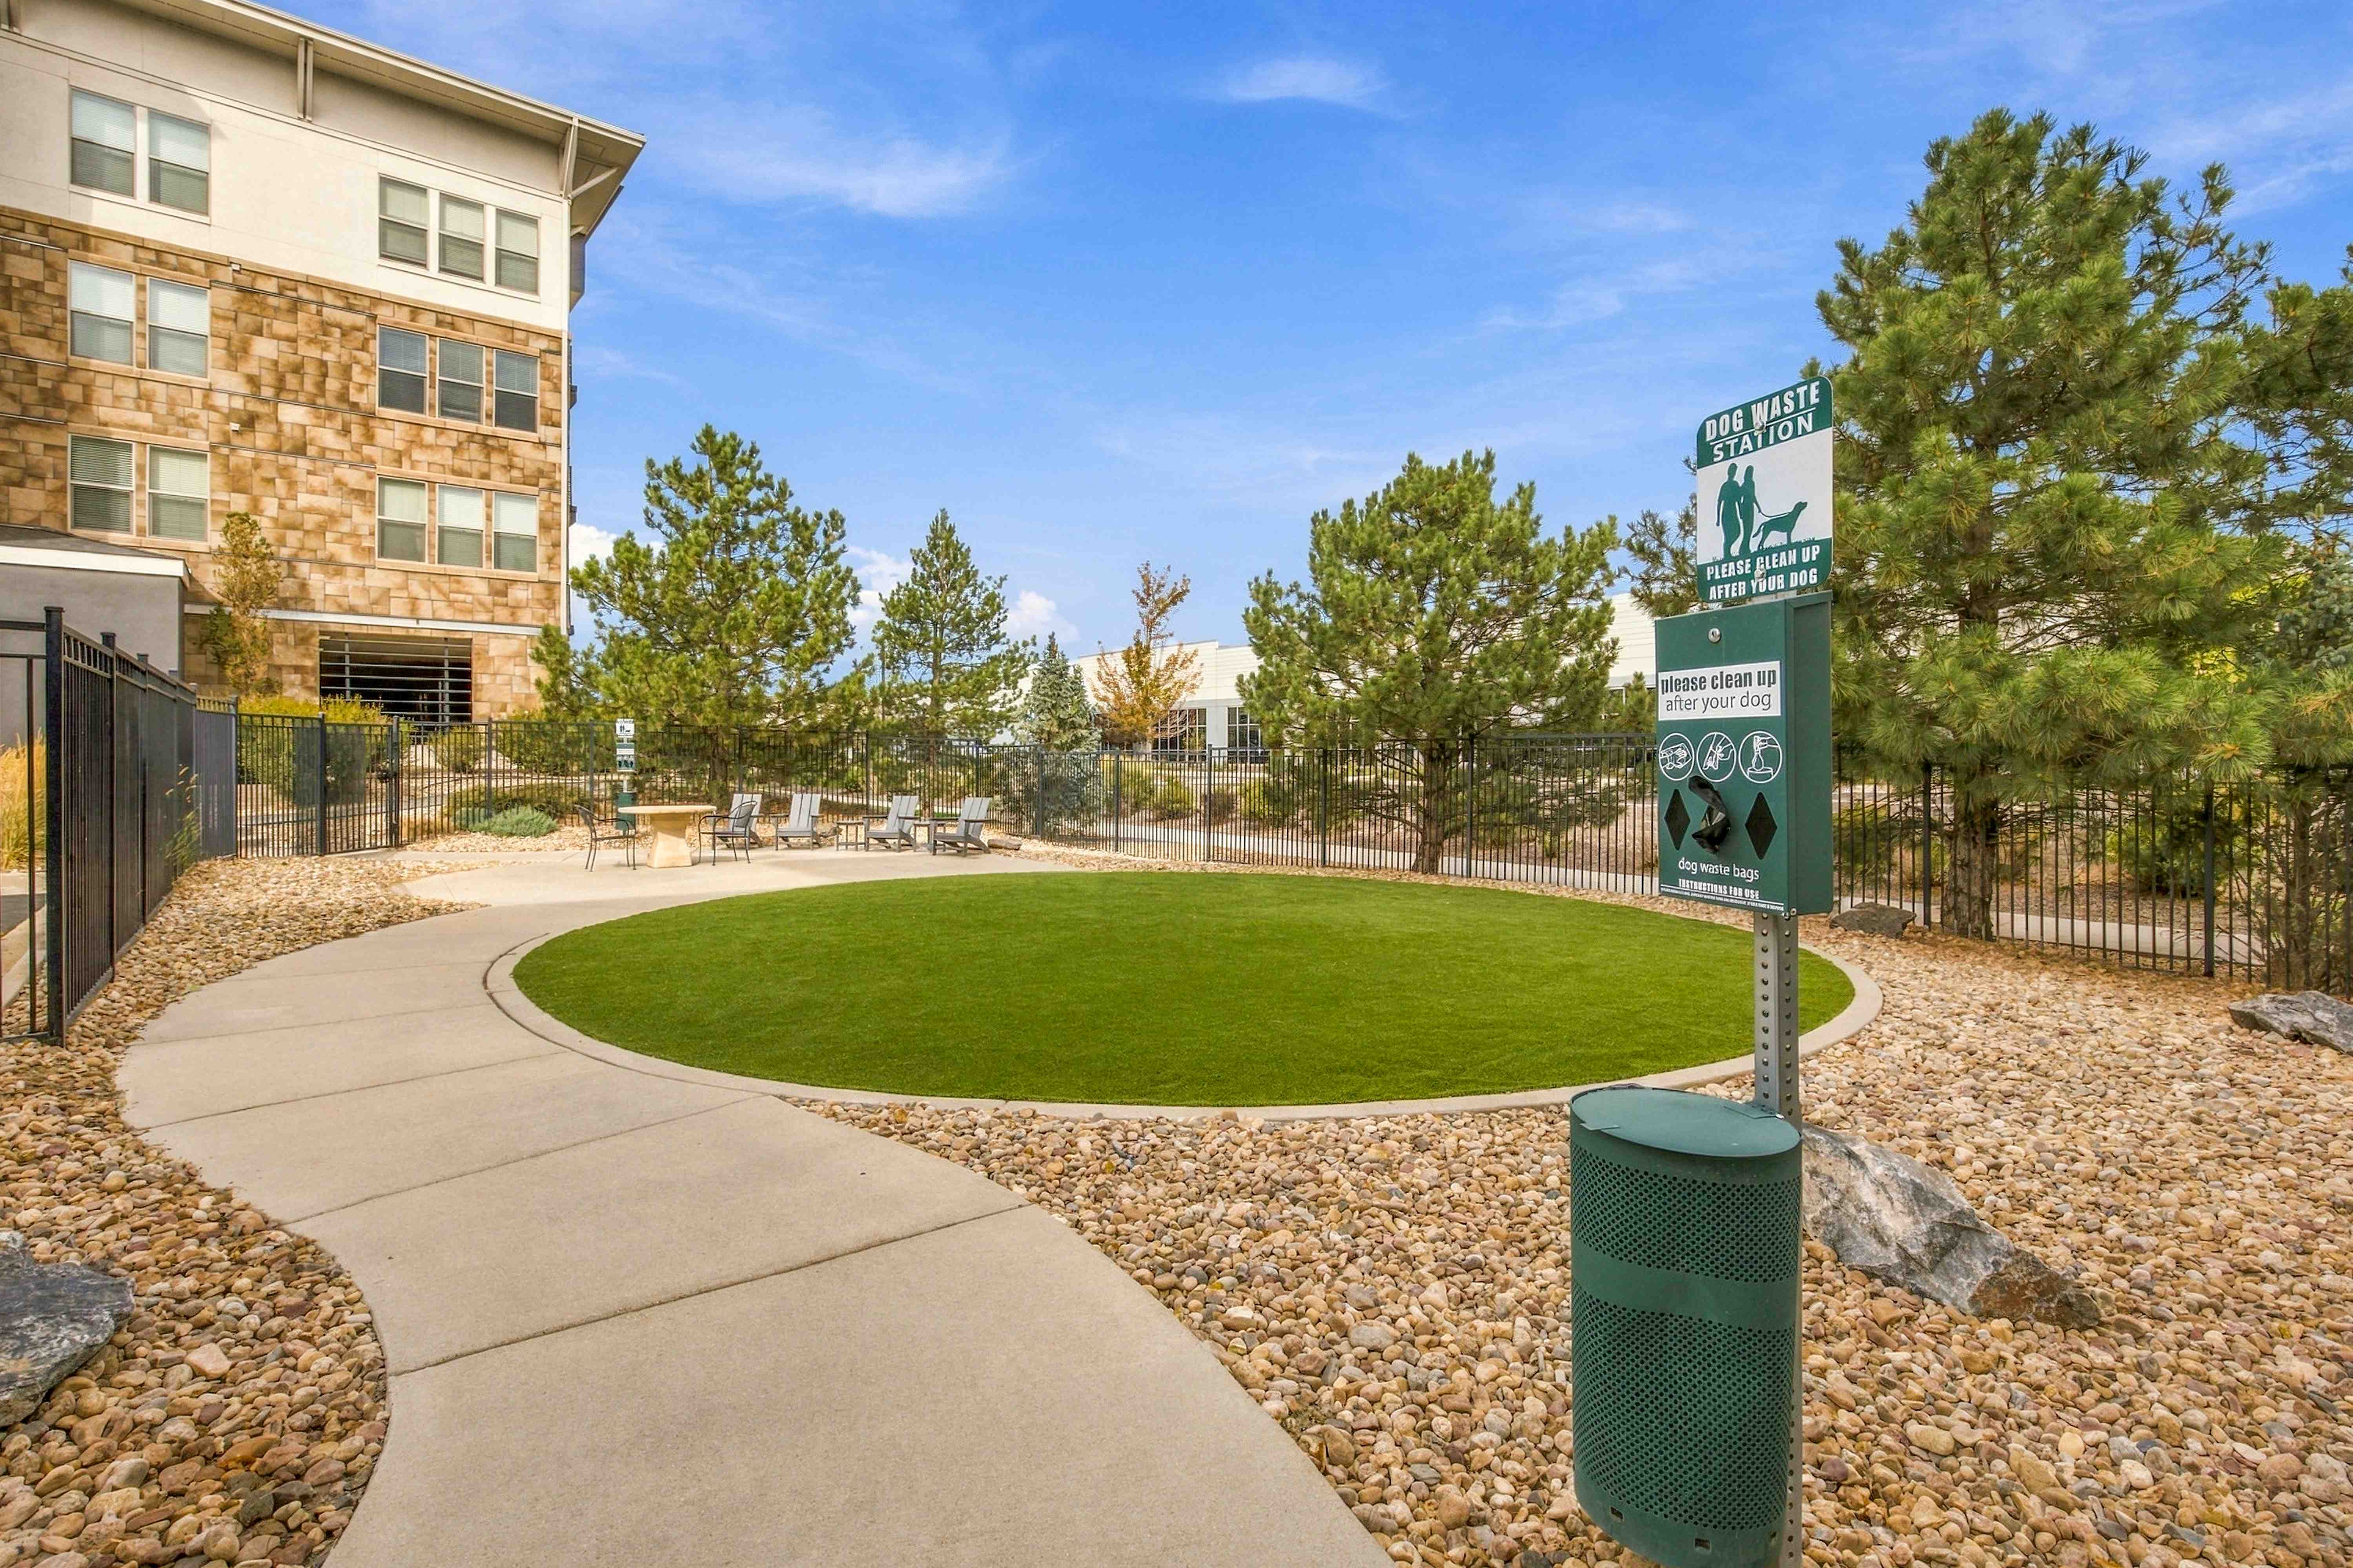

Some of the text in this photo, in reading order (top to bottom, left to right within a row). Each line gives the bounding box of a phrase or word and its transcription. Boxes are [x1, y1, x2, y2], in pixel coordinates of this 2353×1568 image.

[1706, 381, 1820, 442] DOG WASTE
[1713, 412, 1813, 462] STATION
[1707, 545, 1820, 581] PLEASE CLEAN UP
[1709, 568, 1818, 600] AFTER YOUR DOG
[1661, 669, 1776, 695] please clean up
[1666, 690, 1771, 713] after your dog
[1678, 857, 1759, 882] dog waste bags
[1678, 878, 1727, 895] INSTRUCTIONS
[1729, 886, 1743, 897] FOR
[1744, 888, 1759, 899] USE
